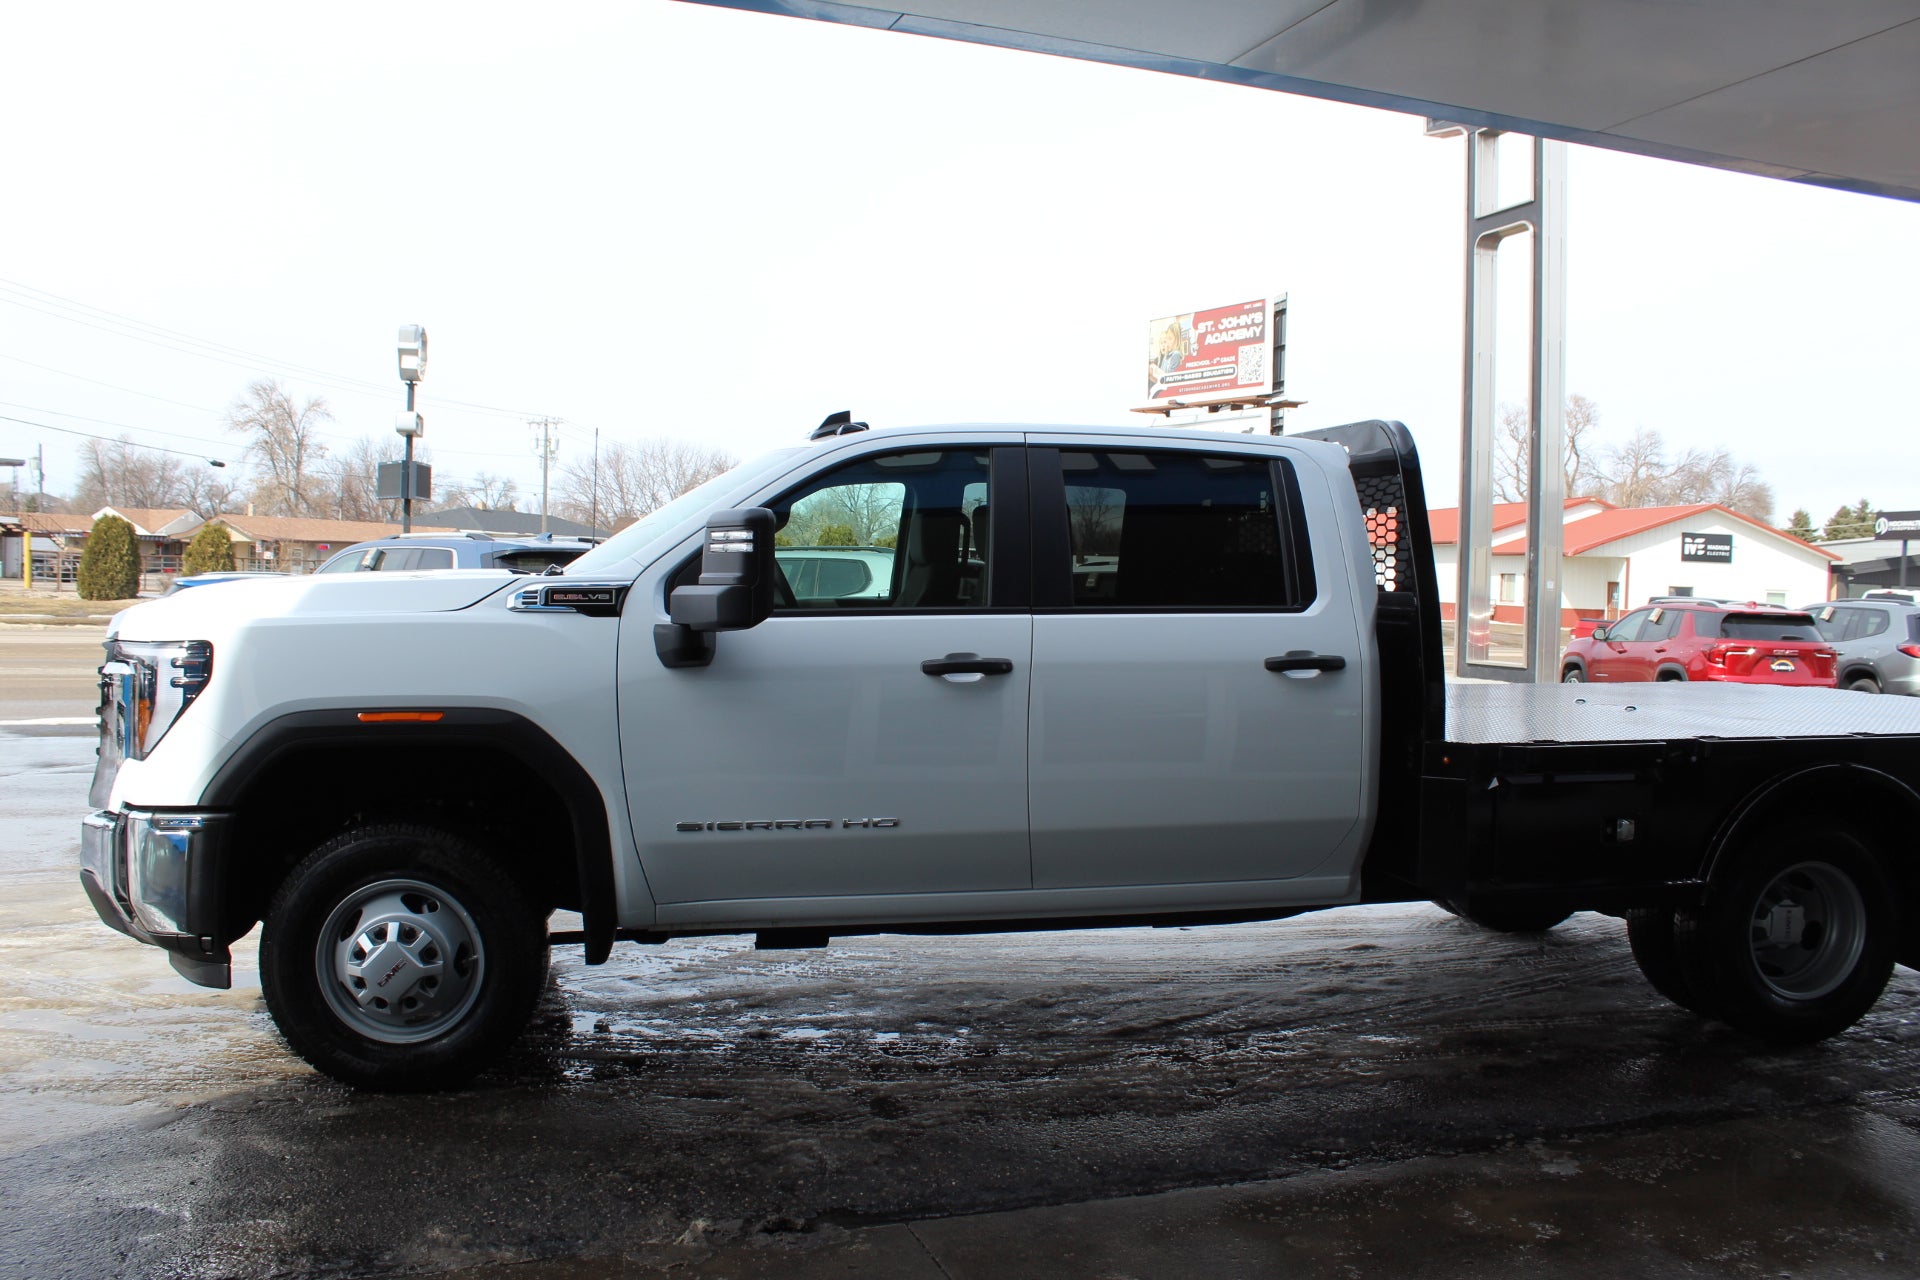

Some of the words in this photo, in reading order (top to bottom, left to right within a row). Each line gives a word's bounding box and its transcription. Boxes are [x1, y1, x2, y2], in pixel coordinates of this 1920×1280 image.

[1198, 320, 1215, 334] ST.
[1218, 311, 1264, 330] JOHN'S
[1204, 325, 1263, 346] ACADEMY
[1203, 367, 1234, 378] EDUCATION
[676, 820, 833, 832] SIERRA
[842, 817, 899, 829] HD
[377, 958, 407, 987] GMC
